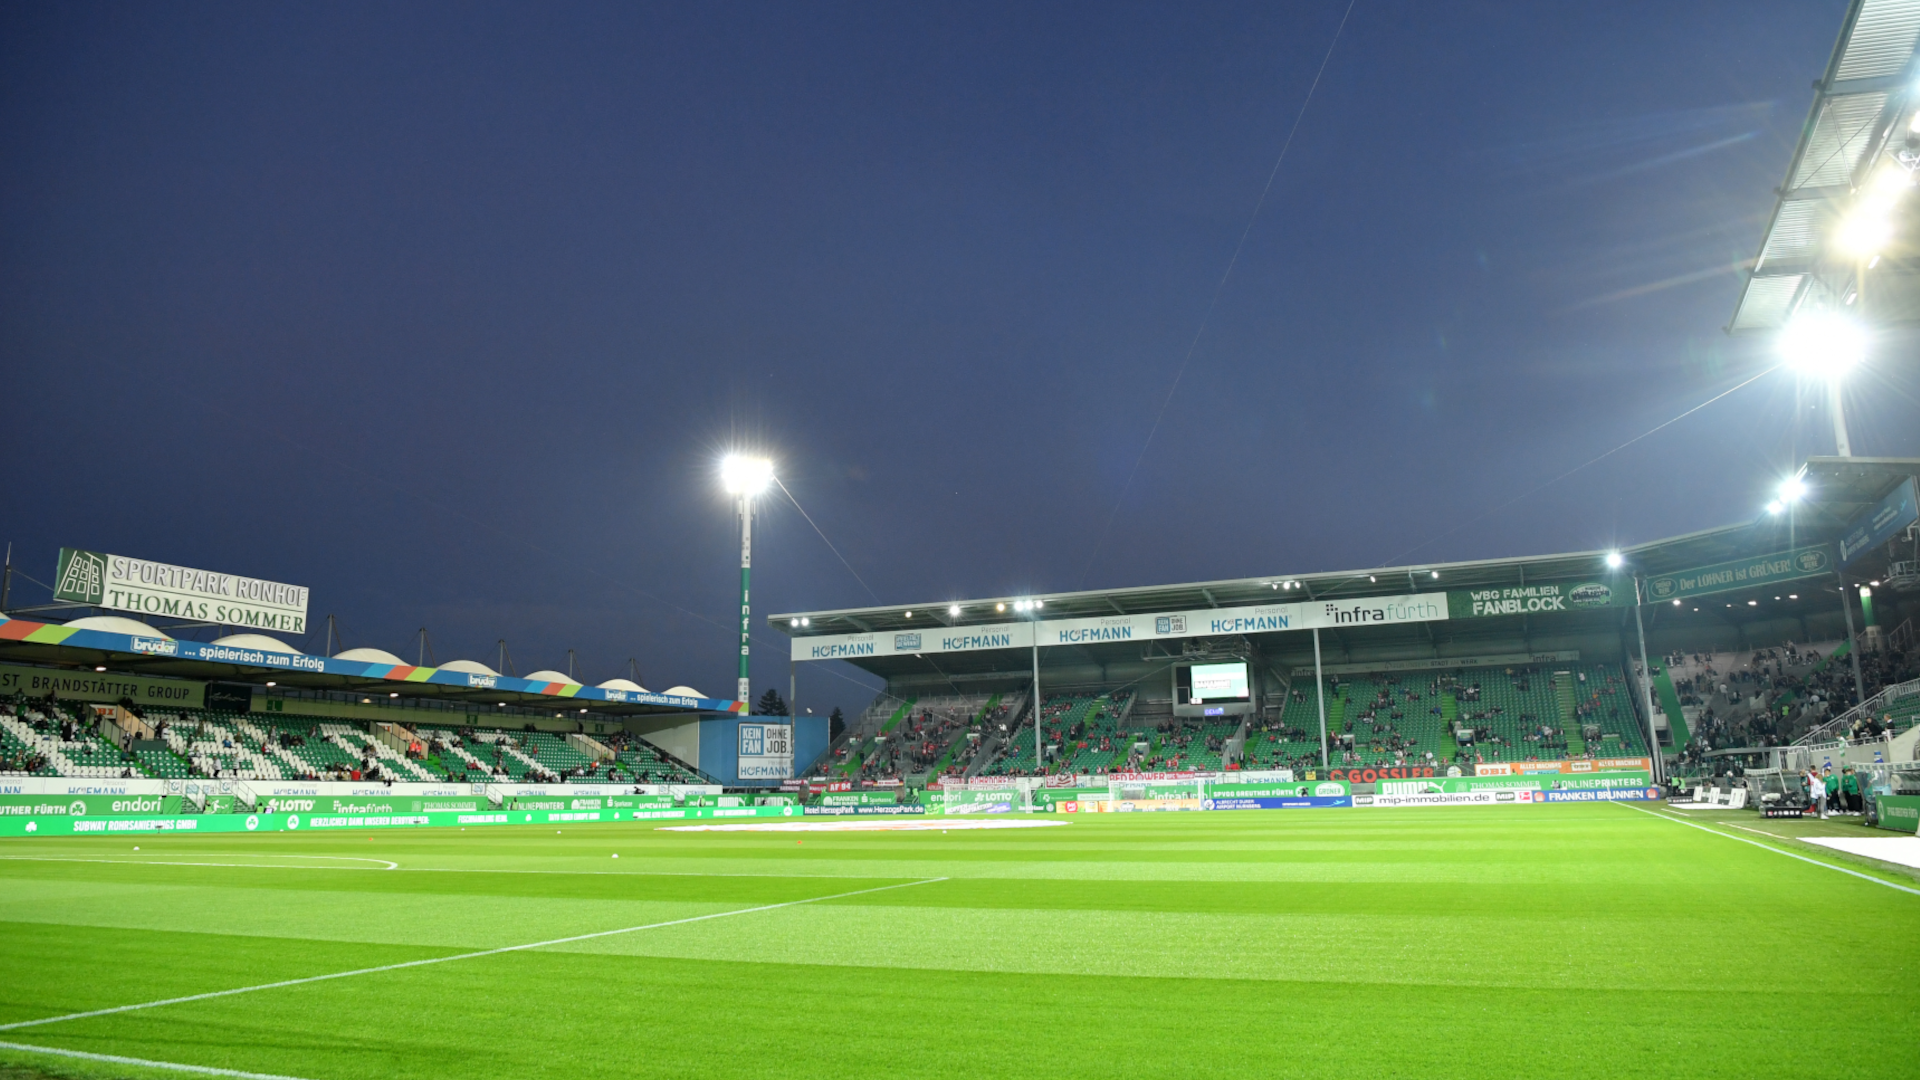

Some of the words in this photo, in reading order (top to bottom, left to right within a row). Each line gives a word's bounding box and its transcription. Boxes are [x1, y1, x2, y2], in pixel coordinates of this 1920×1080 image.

[1680, 578, 1696, 591] Der
[1698, 570, 1734, 588] LOHNER
[1735, 568, 1747, 581] ist
[1749, 558, 1791, 577] GRÜNER!
[112, 557, 230, 596] SPORTPARK
[236, 577, 308, 607] RONHOF
[1470, 590, 1500, 600] WBG
[1503, 585, 1559, 598] FAMILIEN
[108, 589, 209, 620] THOMAS
[215, 604, 305, 633] SOMMER
[1255, 606, 1289, 614] Personal
[1472, 596, 1566, 616] FANBLOCK
[1100, 617, 1131, 625] Personal
[1211, 615, 1289, 633] HOFMANN
[1059, 626, 1131, 642] HOFMANN
[943, 634, 1010, 649] HOFMANN
[812, 642, 874, 658] HOFMANN
[199, 646, 264, 664] spielerisch
[266, 655, 290, 666] zum
[292, 655, 325, 672] Erfolg
[32, 676, 138, 697] BRANDSTÄTTER
[148, 685, 190, 700] GROUP
[669, 696, 681, 704] zum
[742, 728, 762, 739] KEIN
[766, 728, 788, 739] OHNE
[742, 740, 762, 754] FAN
[741, 766, 788, 776] HOFMANN
[1382, 781, 1428, 795] PUMA
[1470, 781, 1505, 789] THOMAS
[1505, 780, 1540, 788] SOMMER
[1561, 778, 1643, 789] ONLINEPRINTERS
[931, 792, 962, 802] endori
[1271, 788, 1294, 796] FÜRTH
[1549, 792, 1595, 801] FRANKEN
[1597, 790, 1644, 800] BRUNNEN
[112, 796, 162, 812] endori
[279, 799, 314, 811] LOTTO
[423, 801, 450, 809] THOMAS
[1356, 796, 1374, 804] MIP
[1379, 793, 1490, 805] mip-immobilien.de
[1496, 793, 1514, 801] MIP
[34, 803, 66, 815] FÜRTH
[517, 802, 564, 811] NLINEPRINTERS
[804, 806, 820, 814] Hotel
[820, 806, 855, 815] HerzogsPark
[858, 806, 924, 815] www.HerzogsPark.de
[73, 820, 107, 831] SUBWAY
[108, 819, 175, 831] ROHRSANIERUNGS
[176, 819, 197, 829] GMBH
[310, 817, 347, 827] HERZLICHEN
[348, 816, 364, 826] DANK
